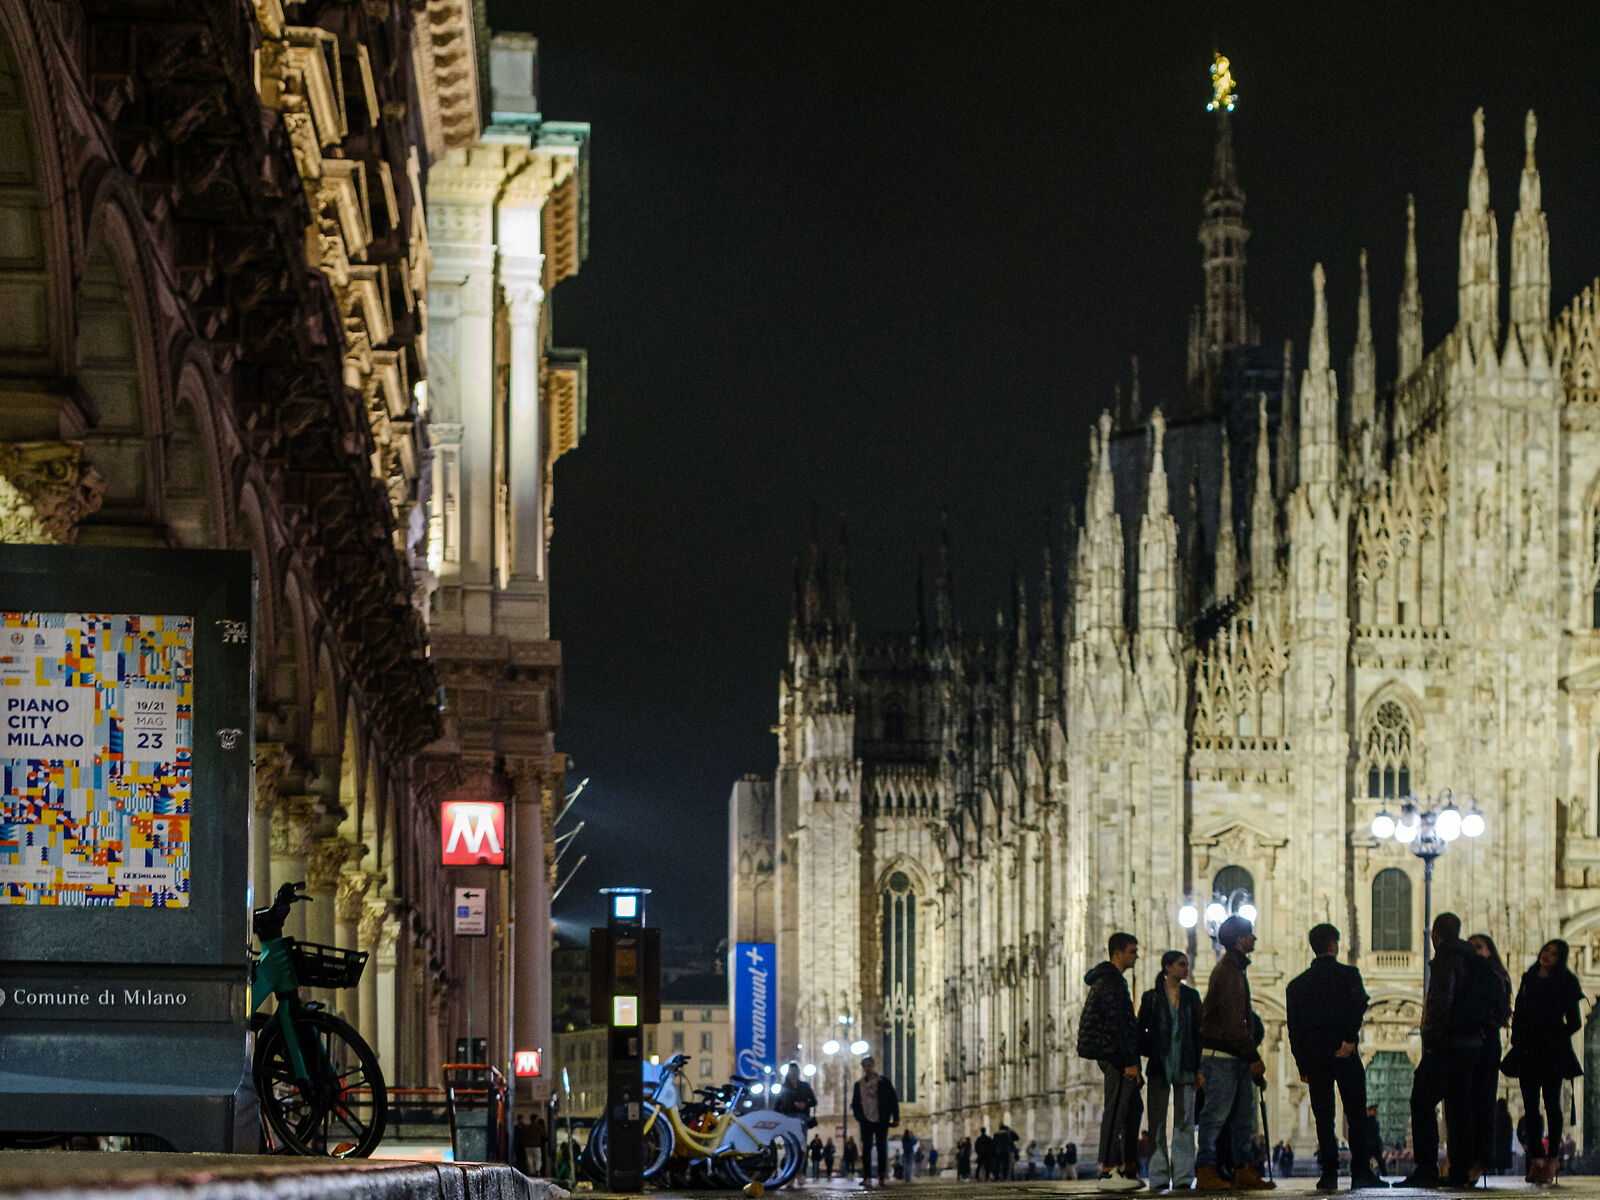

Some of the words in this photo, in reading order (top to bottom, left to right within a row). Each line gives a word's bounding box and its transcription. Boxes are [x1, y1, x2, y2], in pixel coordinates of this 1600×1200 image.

[8, 698, 70, 713] PIANO
[136, 701, 165, 711] 19/21
[7, 715, 52, 729] CITY
[136, 716, 164, 726] MAG
[7, 732, 84, 748] MILANO
[136, 733, 164, 749] 23
[445, 805, 502, 854] M
[13, 988, 91, 1005] Comune
[98, 989, 115, 1005] di
[123, 989, 188, 1005] Milano
[516, 1053, 539, 1073] M
